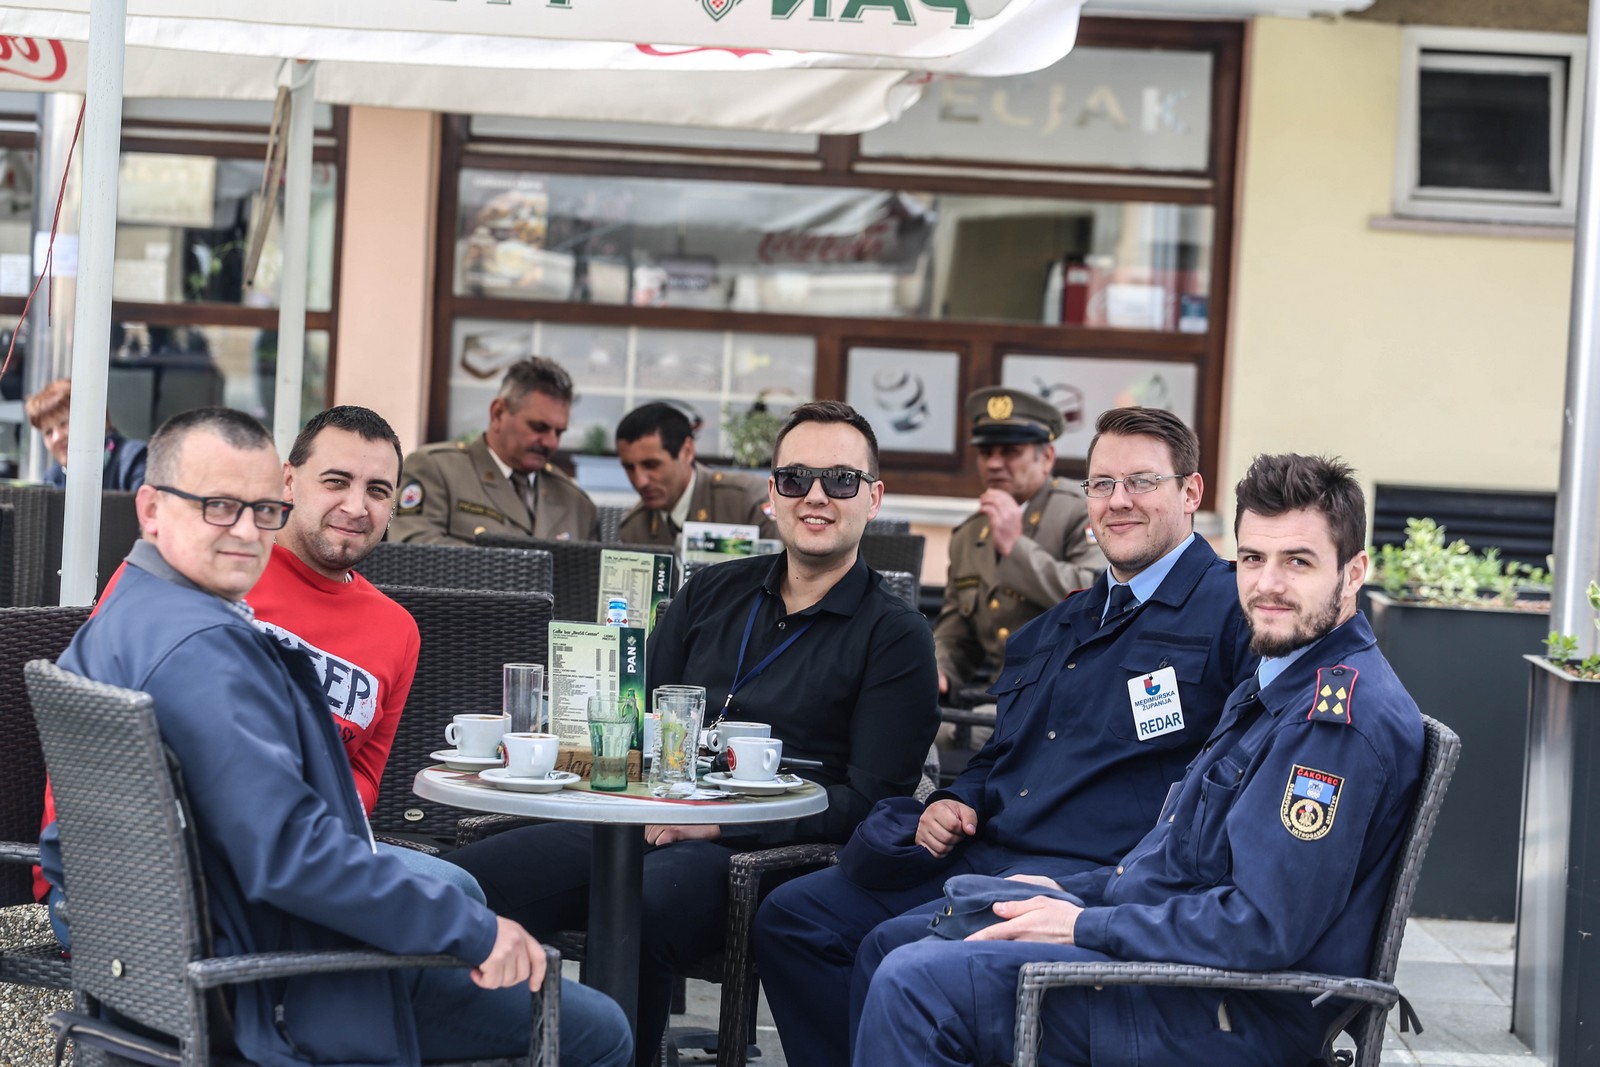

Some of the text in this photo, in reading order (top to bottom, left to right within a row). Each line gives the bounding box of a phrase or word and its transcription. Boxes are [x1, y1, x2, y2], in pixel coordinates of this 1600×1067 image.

[657, 570, 665, 592] PAN
[627, 646, 636, 673] PAN
[264, 627, 370, 720] EP
[1142, 697, 1172, 711] ŽUPANIJA
[1139, 711, 1182, 736] REDAR
[1297, 767, 1339, 786] ČAKOVEC
